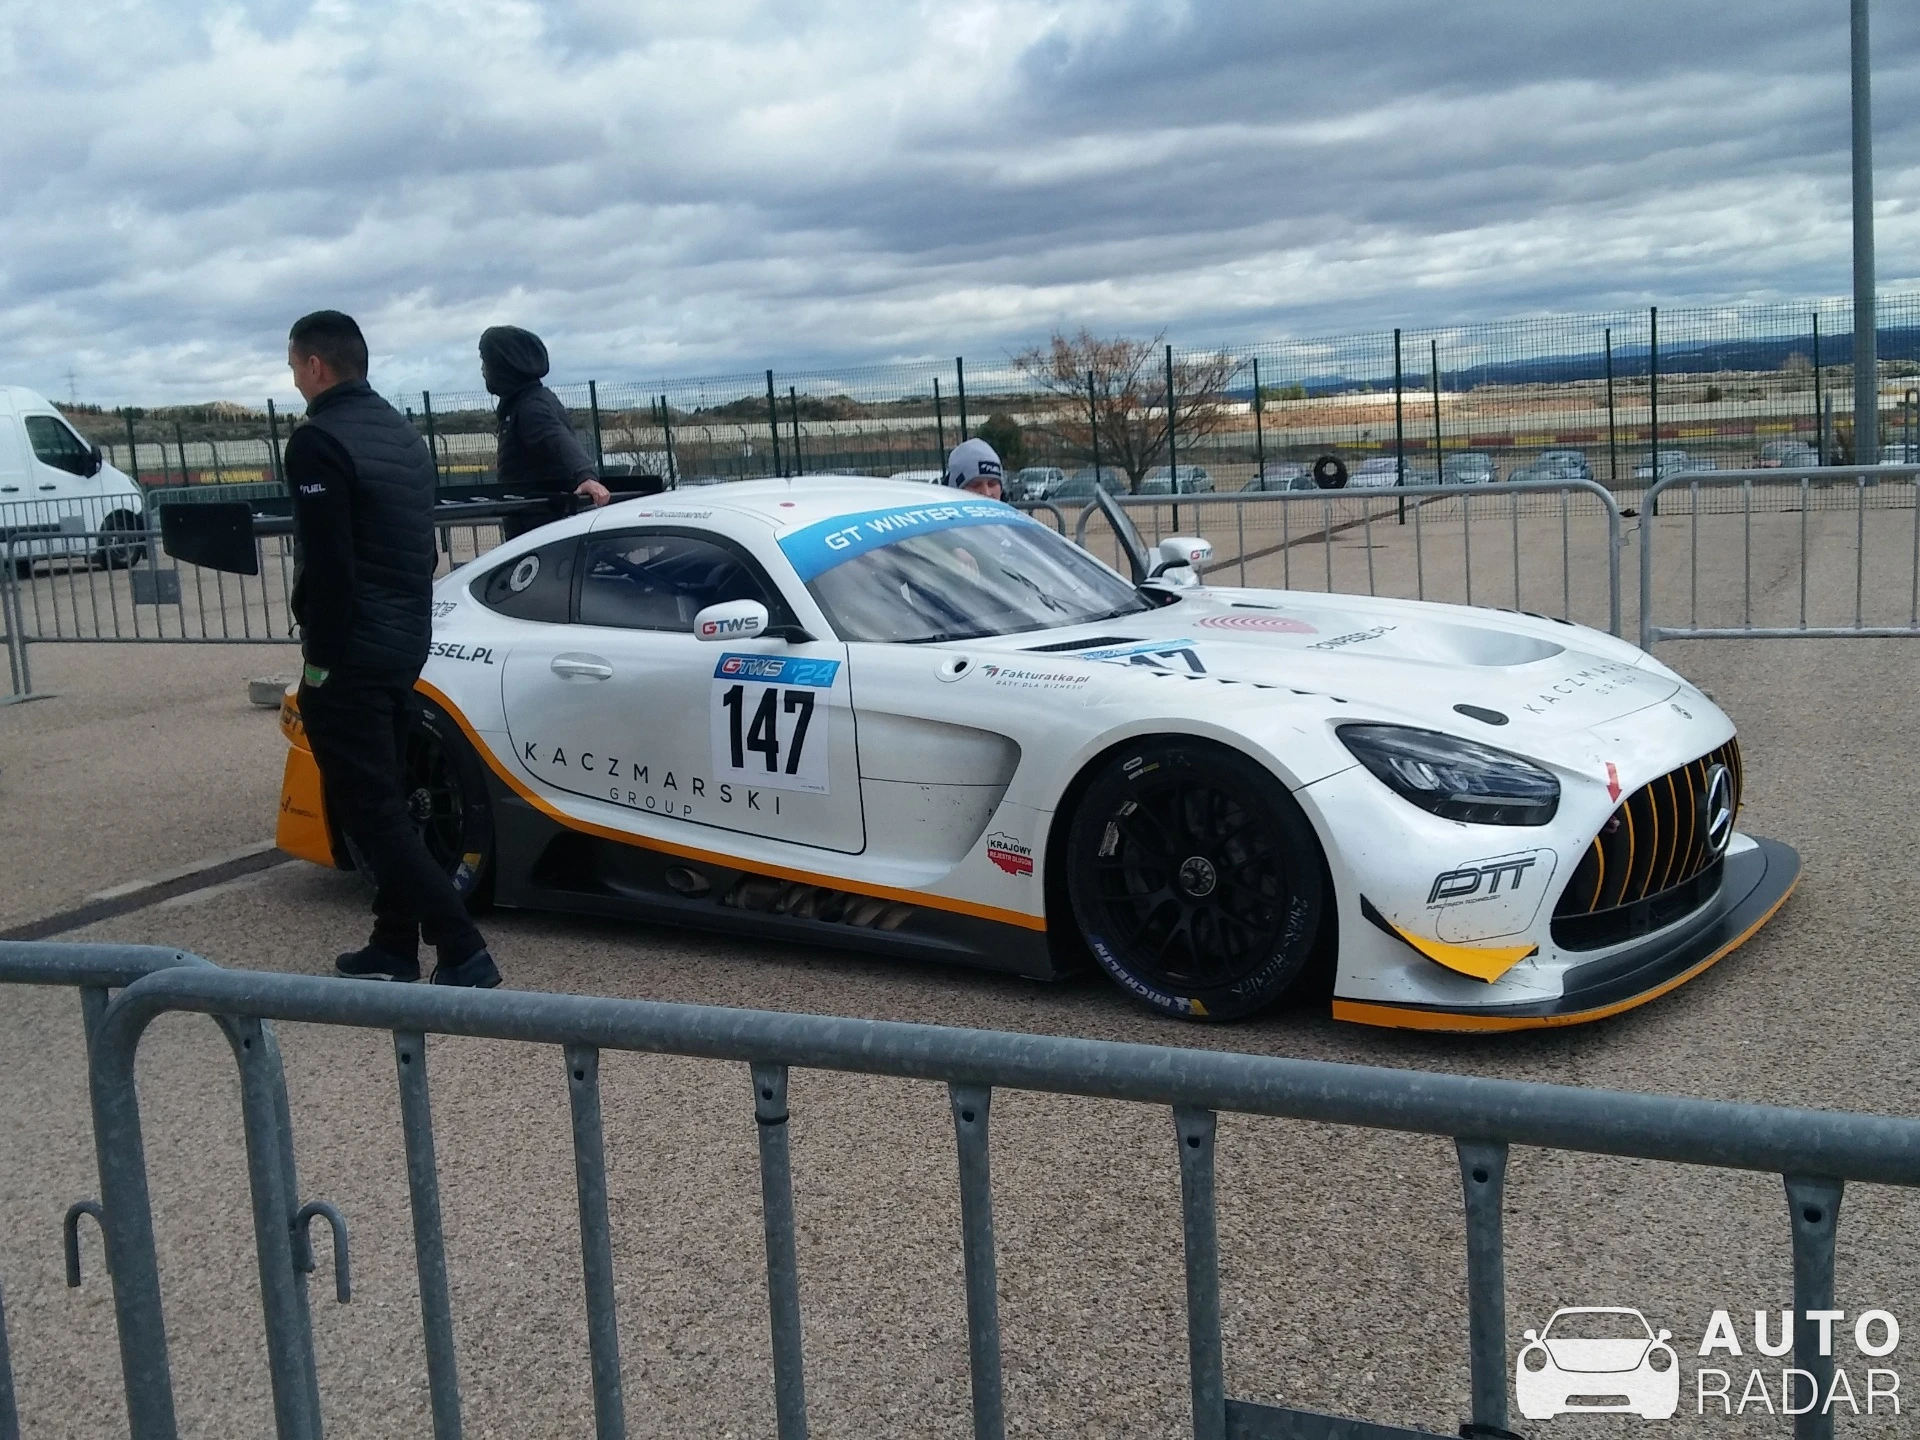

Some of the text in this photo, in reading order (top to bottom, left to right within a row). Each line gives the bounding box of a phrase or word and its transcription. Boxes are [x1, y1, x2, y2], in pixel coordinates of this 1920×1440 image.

[824, 525, 863, 551] GT
[865, 506, 965, 534] WINTER
[702, 616, 759, 635] GTWS
[428, 642, 494, 665] ESEL.PL
[721, 657, 785, 677] GTWS
[1000, 668, 1091, 684] Fakturatka.pl
[722, 685, 816, 776] 147
[525, 741, 781, 815] KACZMARSKI
[609, 787, 693, 818] GROUP
[990, 840, 1032, 856] KRAJOWY
[1426, 857, 1537, 904] PTT
[1094, 942, 1172, 1008] MICHELIN
